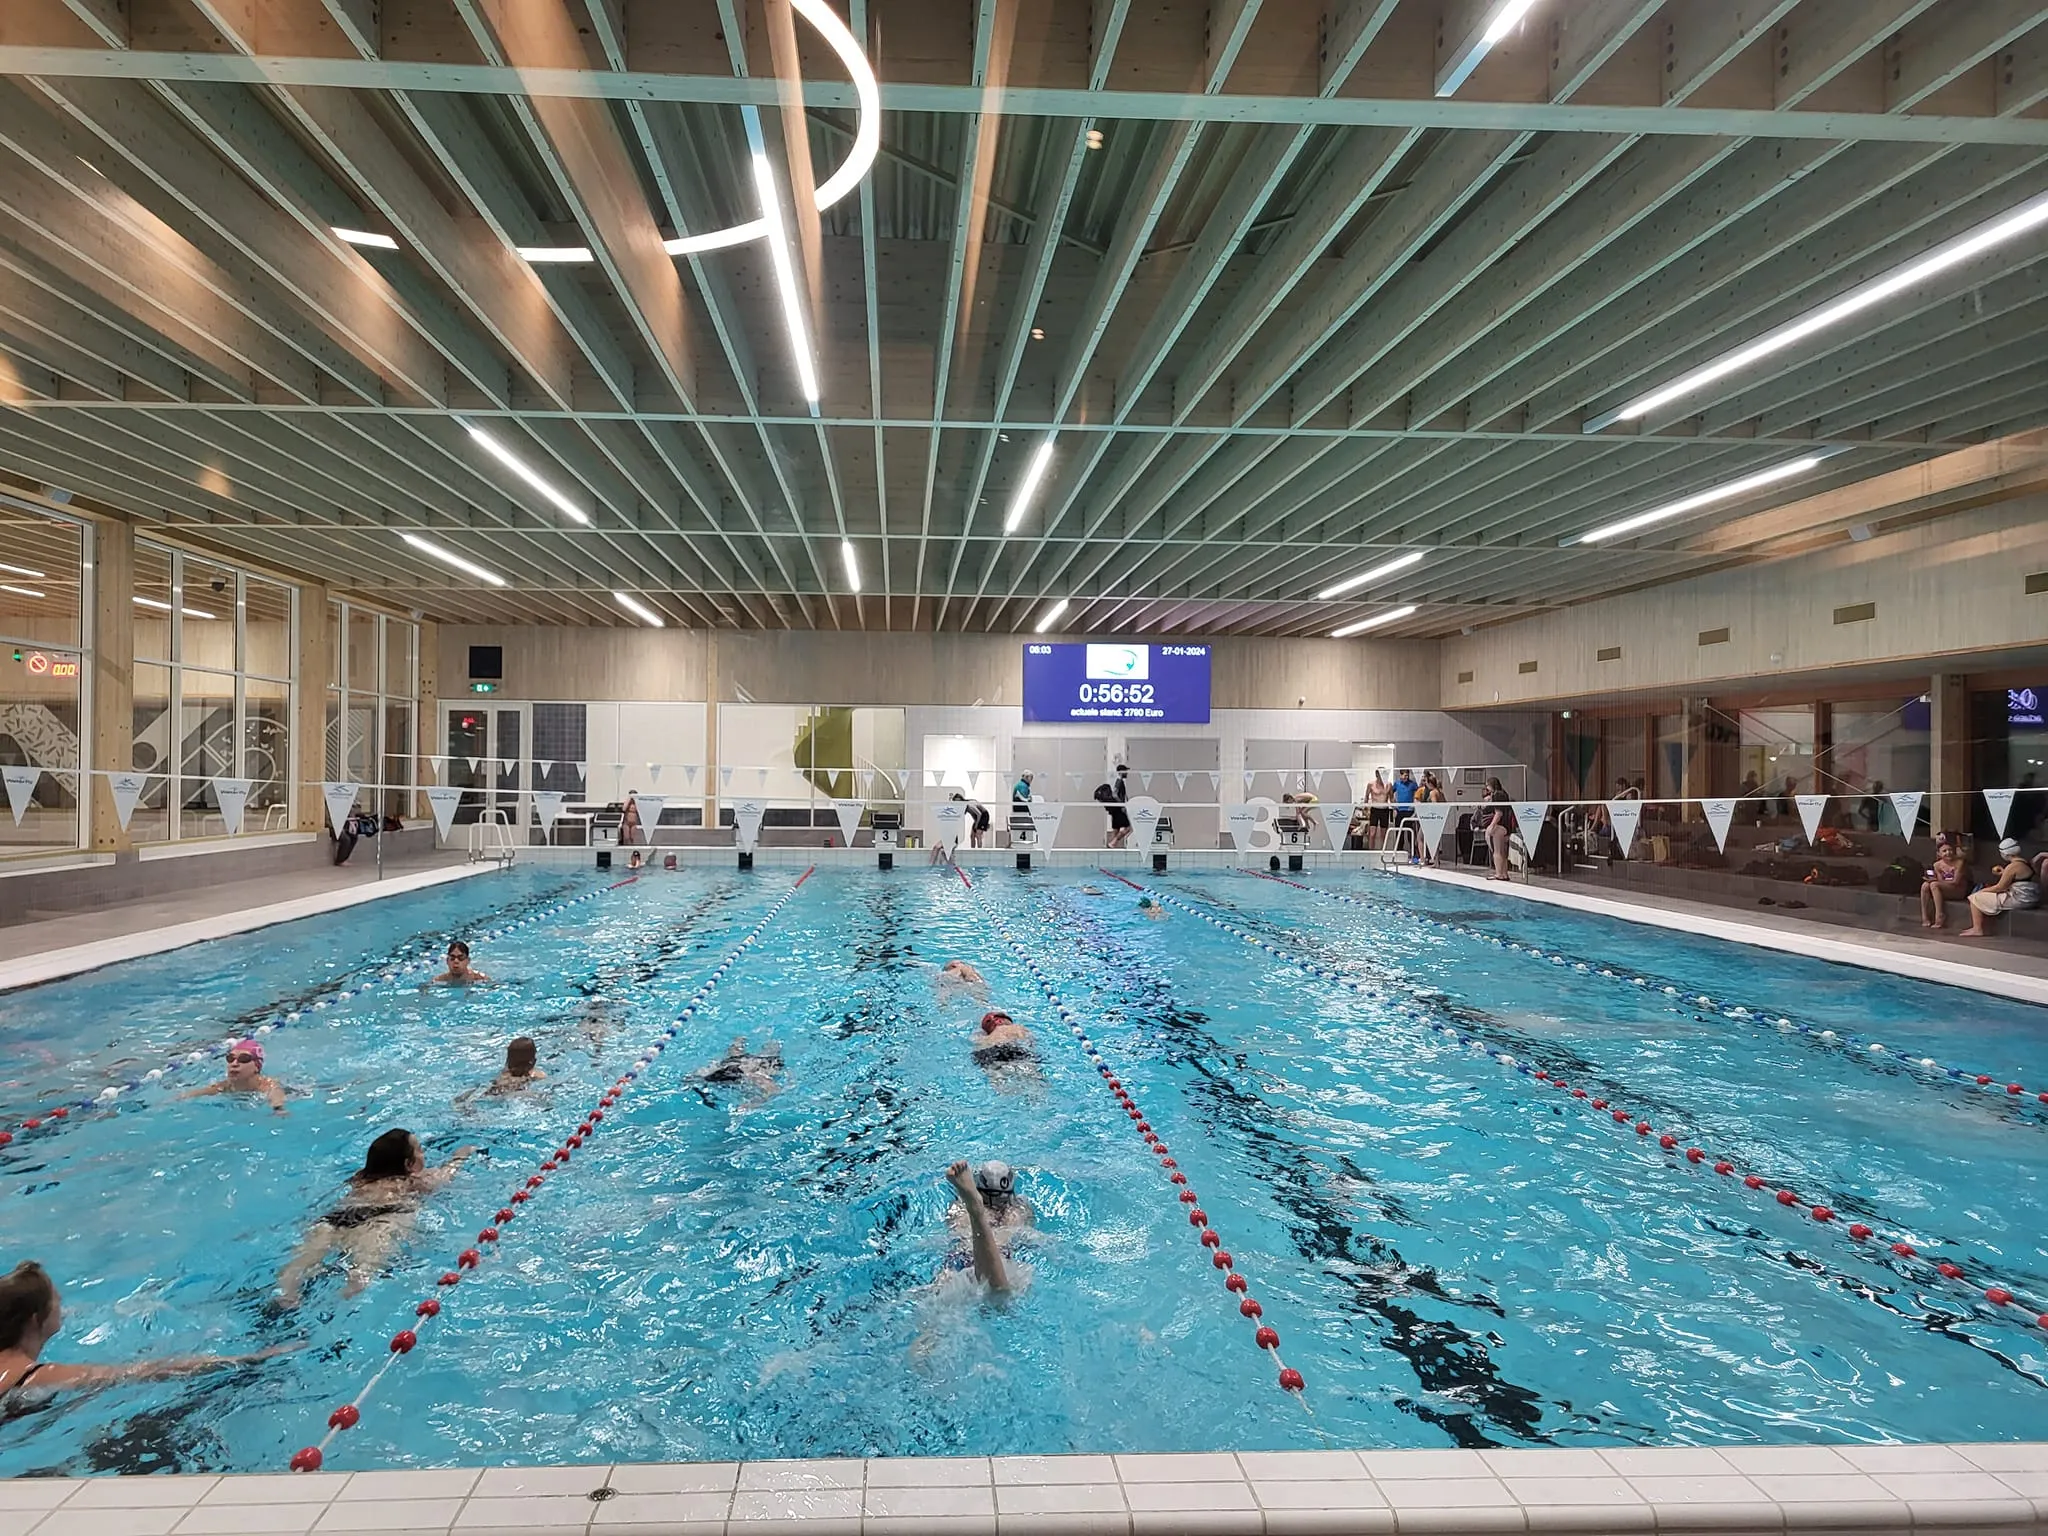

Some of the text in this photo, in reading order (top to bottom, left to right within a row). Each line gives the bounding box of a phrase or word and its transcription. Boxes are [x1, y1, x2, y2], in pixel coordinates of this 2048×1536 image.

[1162, 646, 1206, 655] 27-01-2024
[1079, 683, 1154, 703] 0:56:52
[1099, 708, 1123, 716] stand:
[1145, 708, 1164, 717] Euro
[601, 828, 608, 839] 1
[882, 830, 889, 840] 3
[1020, 831, 1026, 840] 4
[1156, 831, 1162, 841] 5
[1291, 832, 1298, 843] 6
